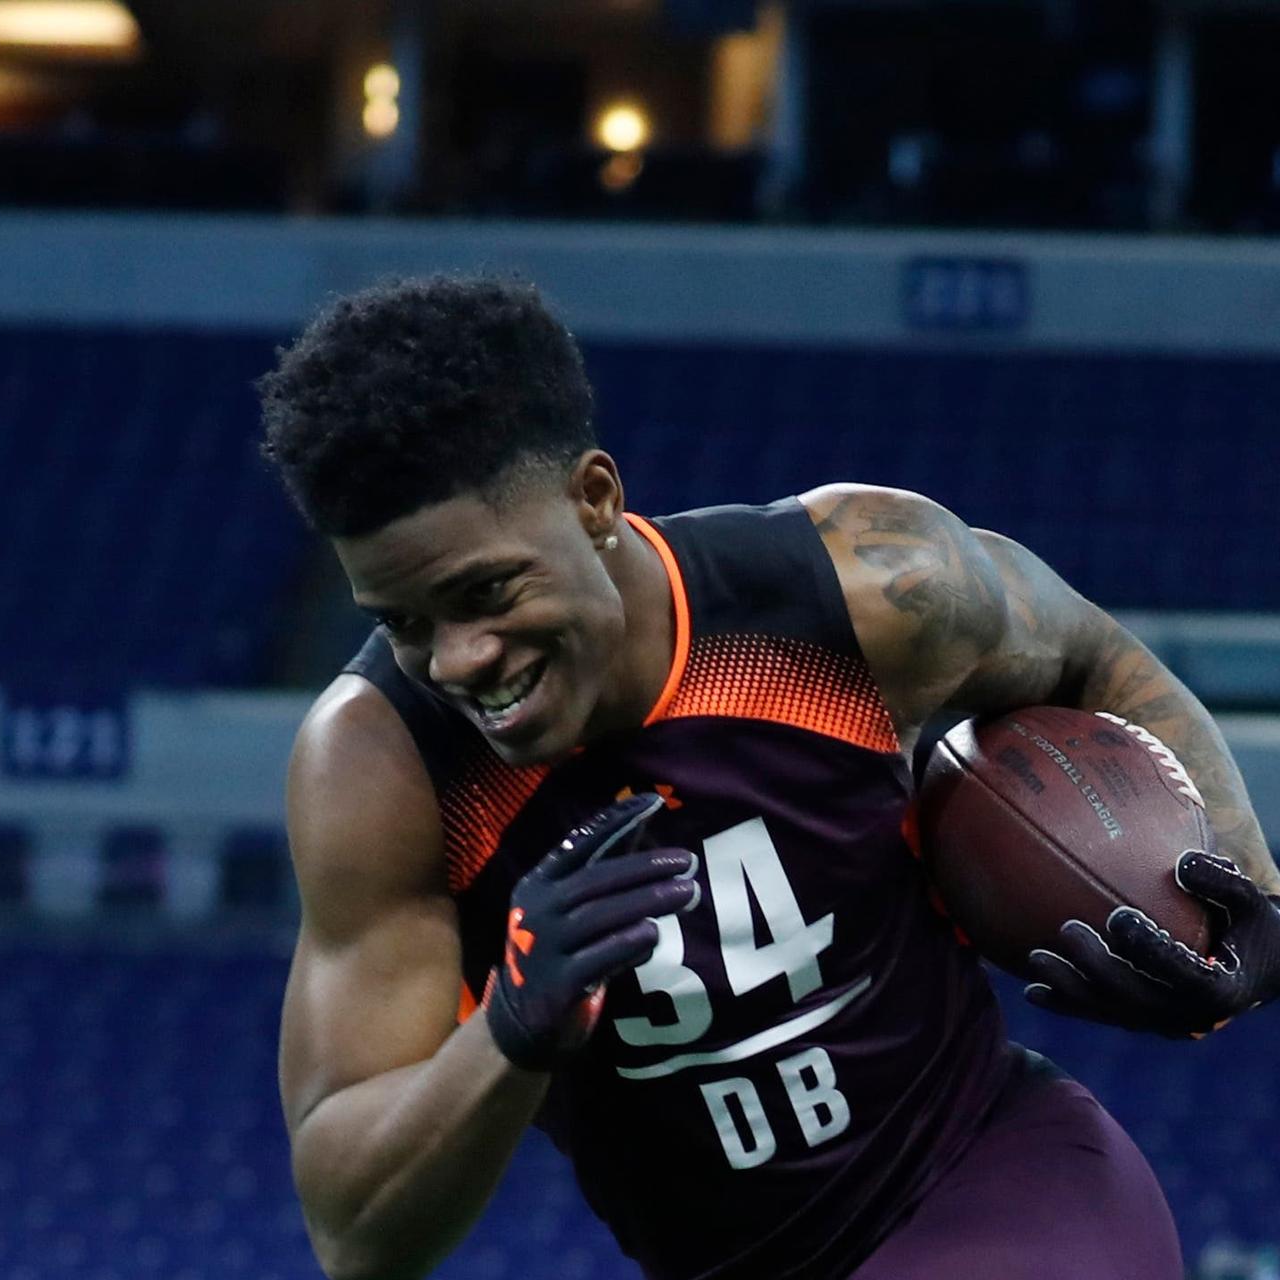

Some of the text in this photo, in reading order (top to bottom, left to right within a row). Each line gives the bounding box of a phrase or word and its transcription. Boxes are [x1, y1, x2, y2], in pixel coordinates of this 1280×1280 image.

[1030, 734, 1085, 785] FOOTBALL
[1081, 783, 1123, 841] LEAGUE
[613, 816, 835, 1047] 34
